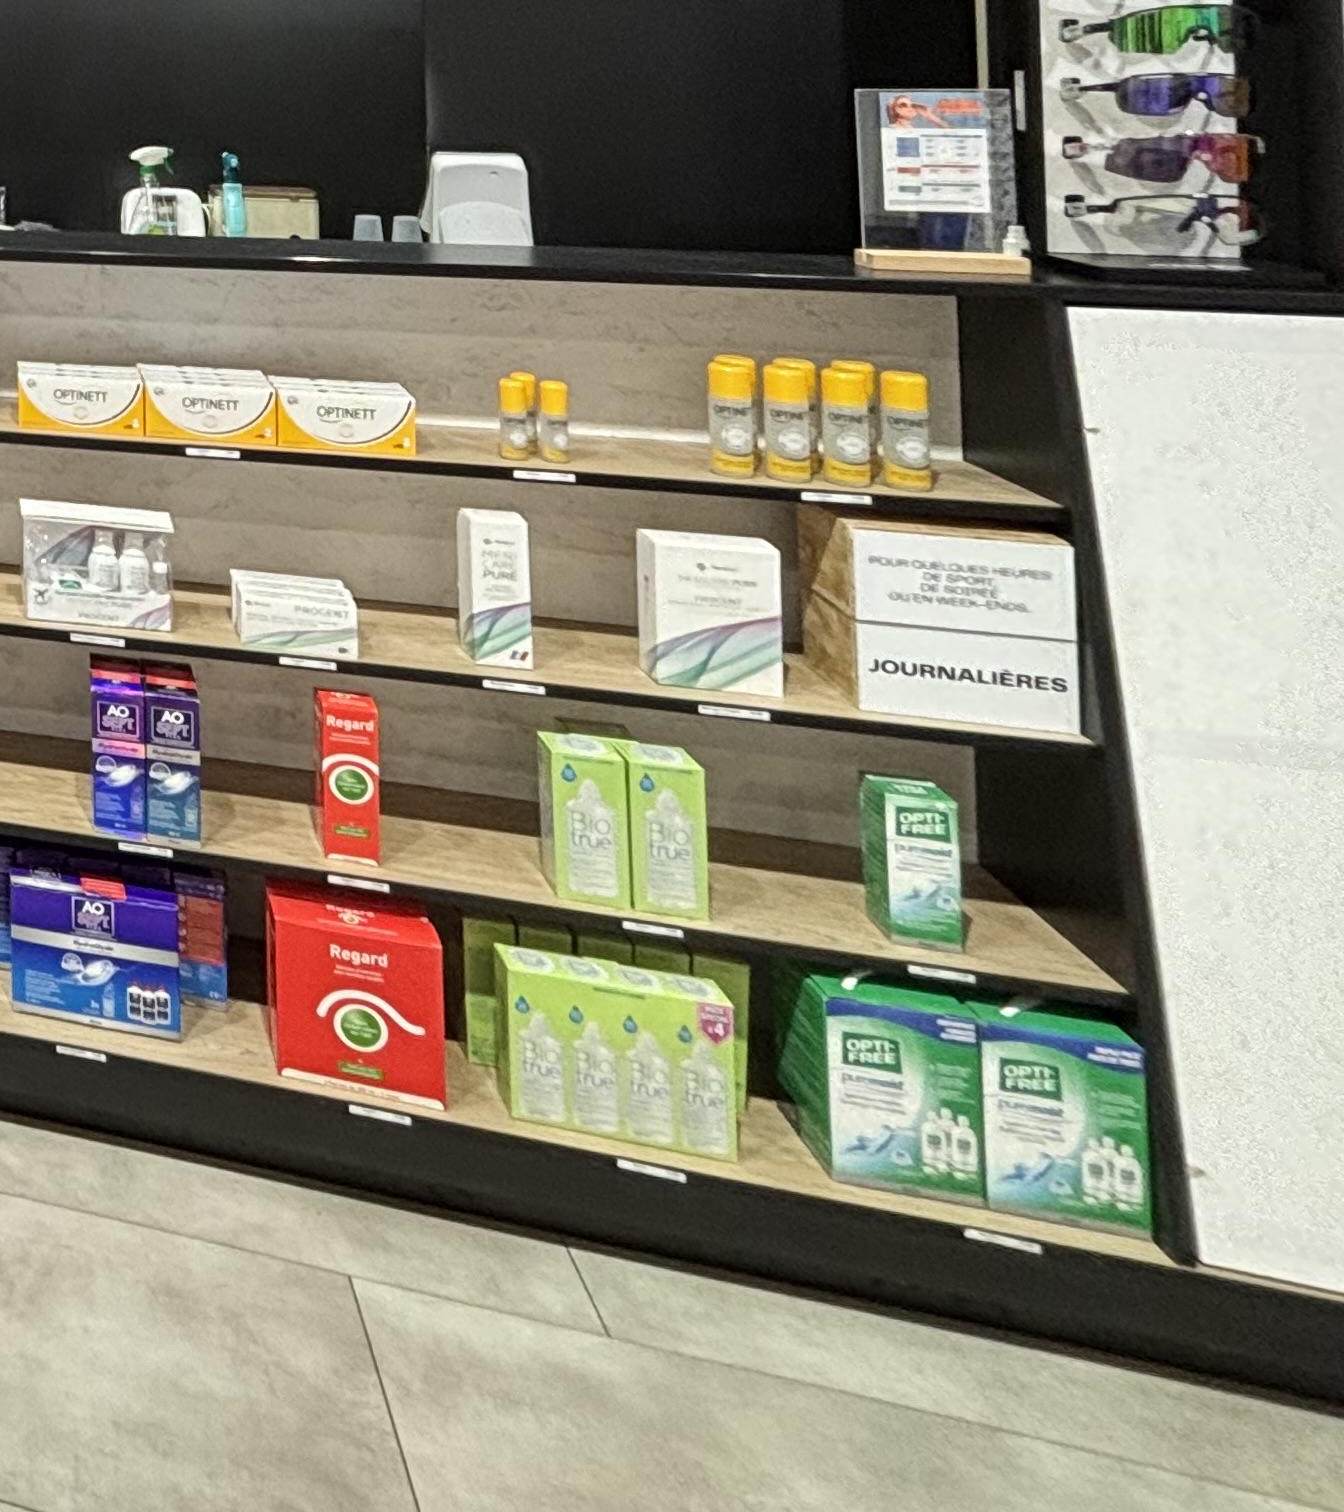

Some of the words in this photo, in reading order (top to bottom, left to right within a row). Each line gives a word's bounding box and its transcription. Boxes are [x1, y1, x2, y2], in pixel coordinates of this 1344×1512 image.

[53, 388, 108, 404] OPTINETT
[182, 397, 240, 412] OPTINETT
[316, 406, 377, 421] OPTINETT
[869, 659, 1068, 693] JOURNALIÈRES
[107, 704, 130, 718] AO
[161, 710, 185, 725] AO
[326, 715, 375, 732] Regard
[899, 811, 945, 825] OPTI-
[900, 823, 947, 836] FREE
[570, 831, 613, 850] true
[649, 841, 692, 861] true
[81, 901, 105, 916] AO
[329, 944, 389, 968] Regard
[846, 1038, 896, 1055] OPTI-
[847, 1051, 896, 1066] FREE
[1002, 1064, 1055, 1080] OPTI-
[1005, 1077, 1057, 1093] FREE
